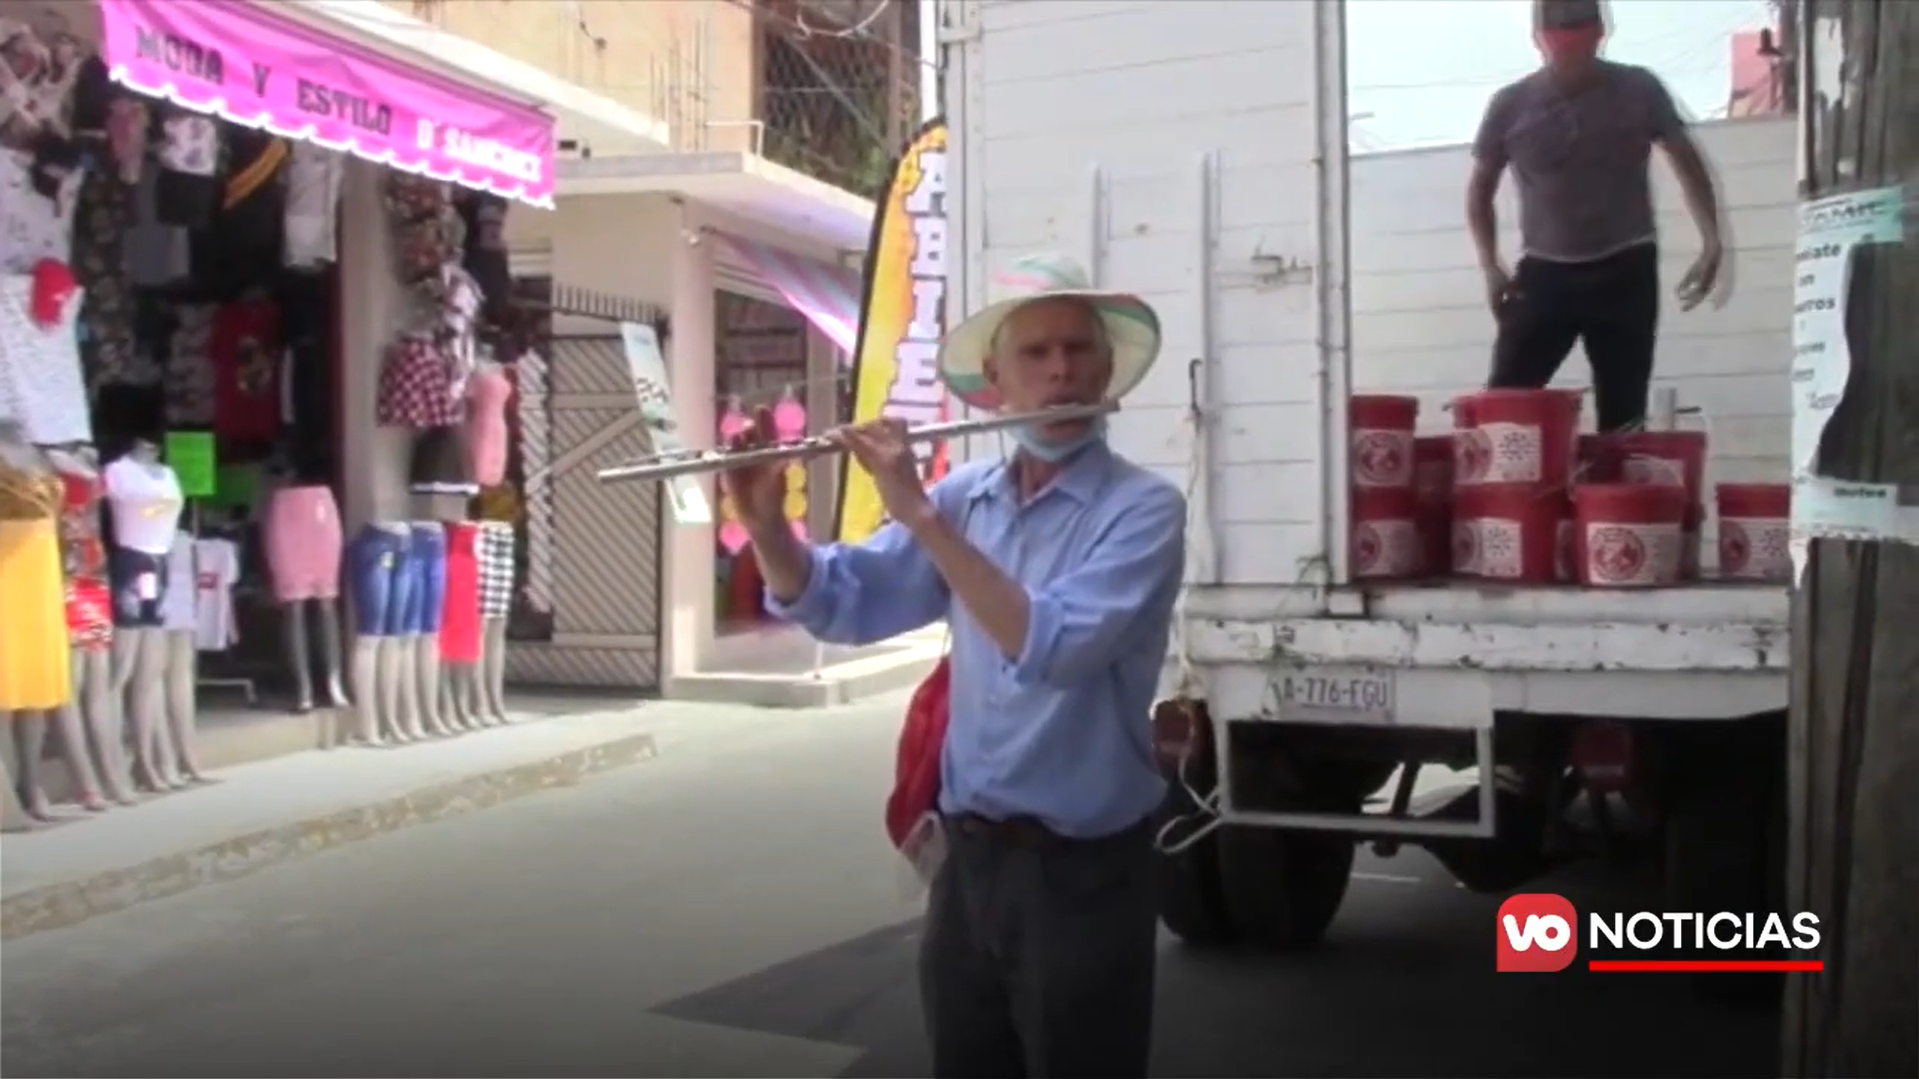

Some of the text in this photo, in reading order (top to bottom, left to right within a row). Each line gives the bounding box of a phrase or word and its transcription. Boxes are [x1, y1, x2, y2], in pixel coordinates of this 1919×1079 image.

[136, 24, 224, 85] MODA
[253, 62, 271, 98] Y
[297, 79, 391, 135] ESTILO
